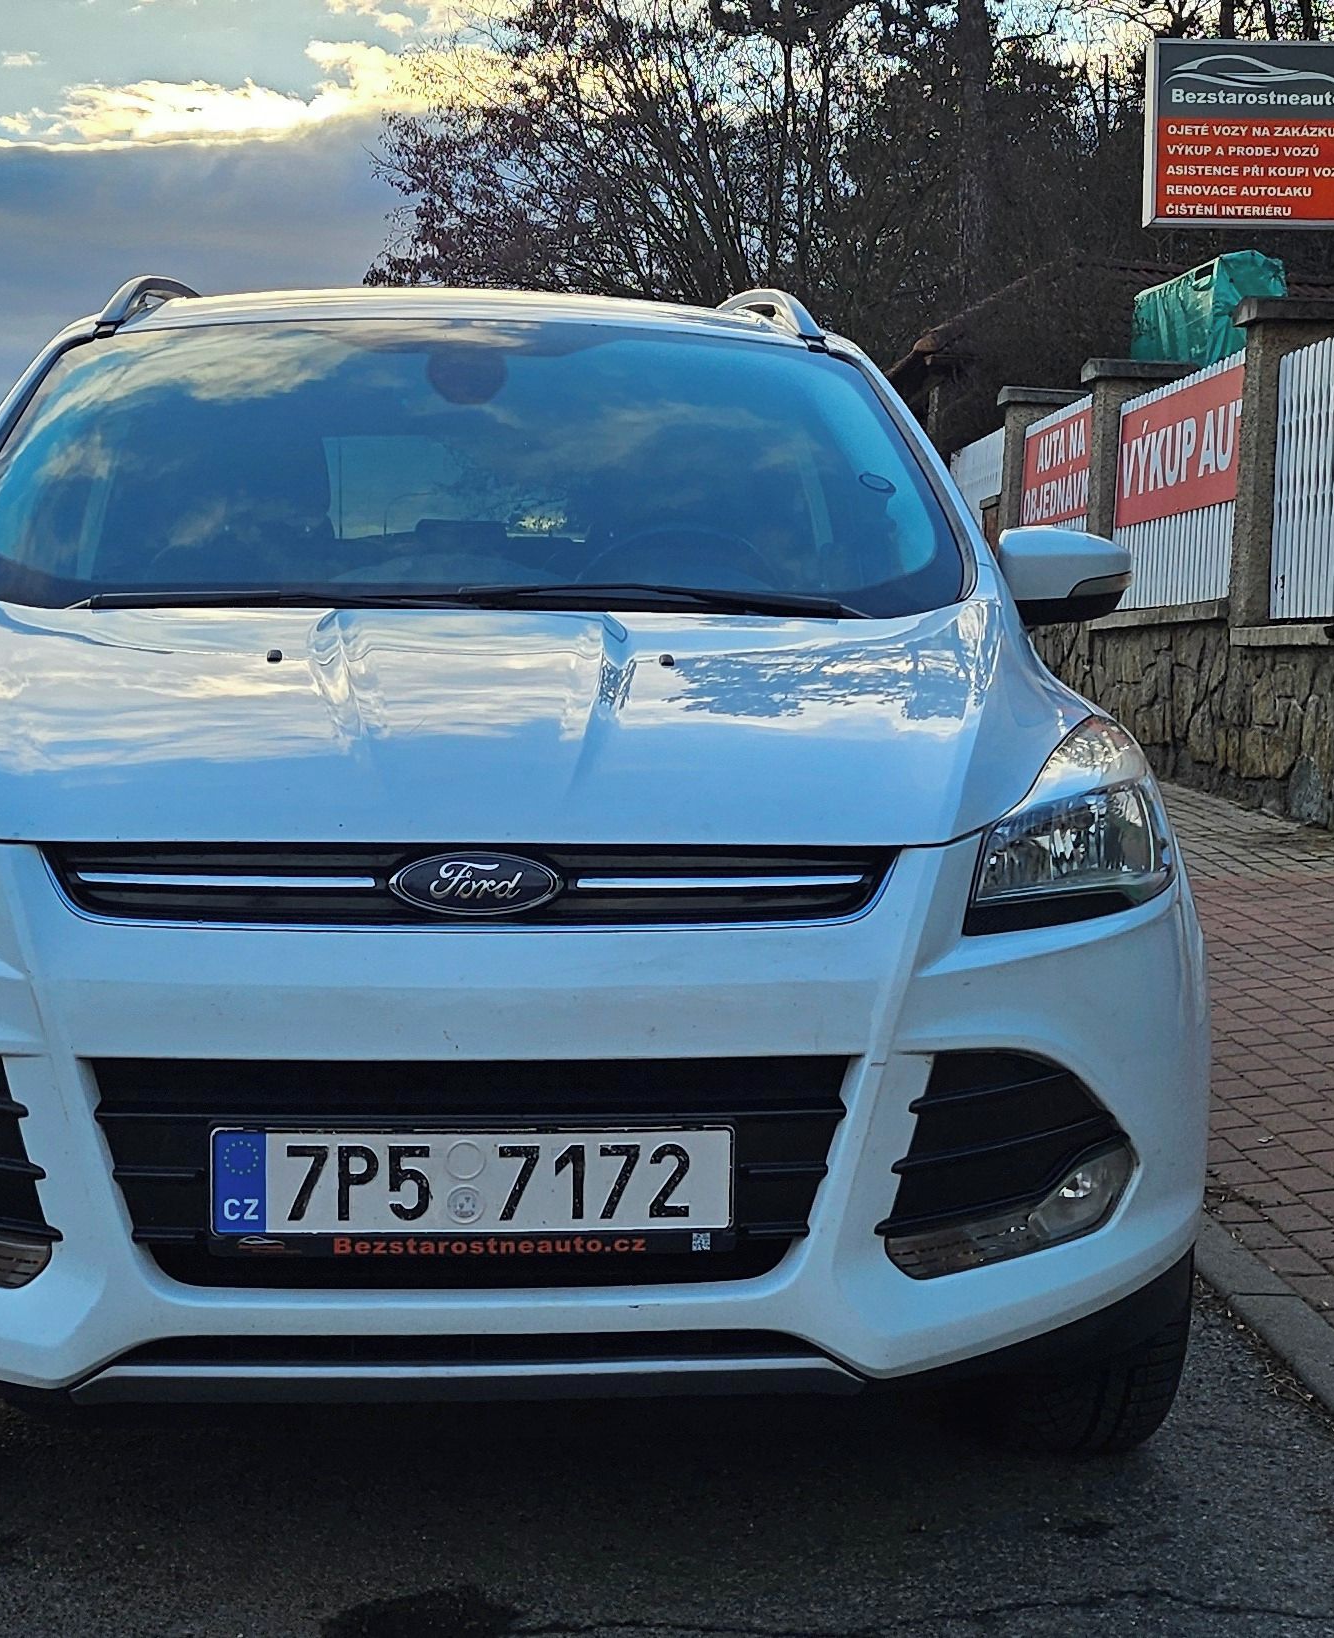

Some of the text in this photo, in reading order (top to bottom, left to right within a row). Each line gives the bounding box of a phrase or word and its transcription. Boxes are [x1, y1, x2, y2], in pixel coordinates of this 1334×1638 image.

[1167, 123, 1210, 136] OJETÉ
[1212, 125, 1249, 137] VOZY
[1251, 126, 1271, 137] NA
[1166, 142, 1320, 157] VÝKUP A PRODEJ VOZŮ
[1166, 164, 1240, 176] ASISTENCE
[1242, 164, 1265, 177] PŘI
[1267, 166, 1310, 178] KOUPI
[1166, 184, 1313, 197] RENOVACE AUTOLAKU
[1165, 202, 1293, 217] ČIŠTĚNÍ INTERIÉRU
[1036, 417, 1086, 475] AUTA NA
[1122, 419, 1197, 499] VÝKUP
[429, 861, 523, 900] Ford
[222, 1143, 691, 1222] CZ 7P5 7172
[332, 1235, 648, 1256] Bezstarostneauto.cz
